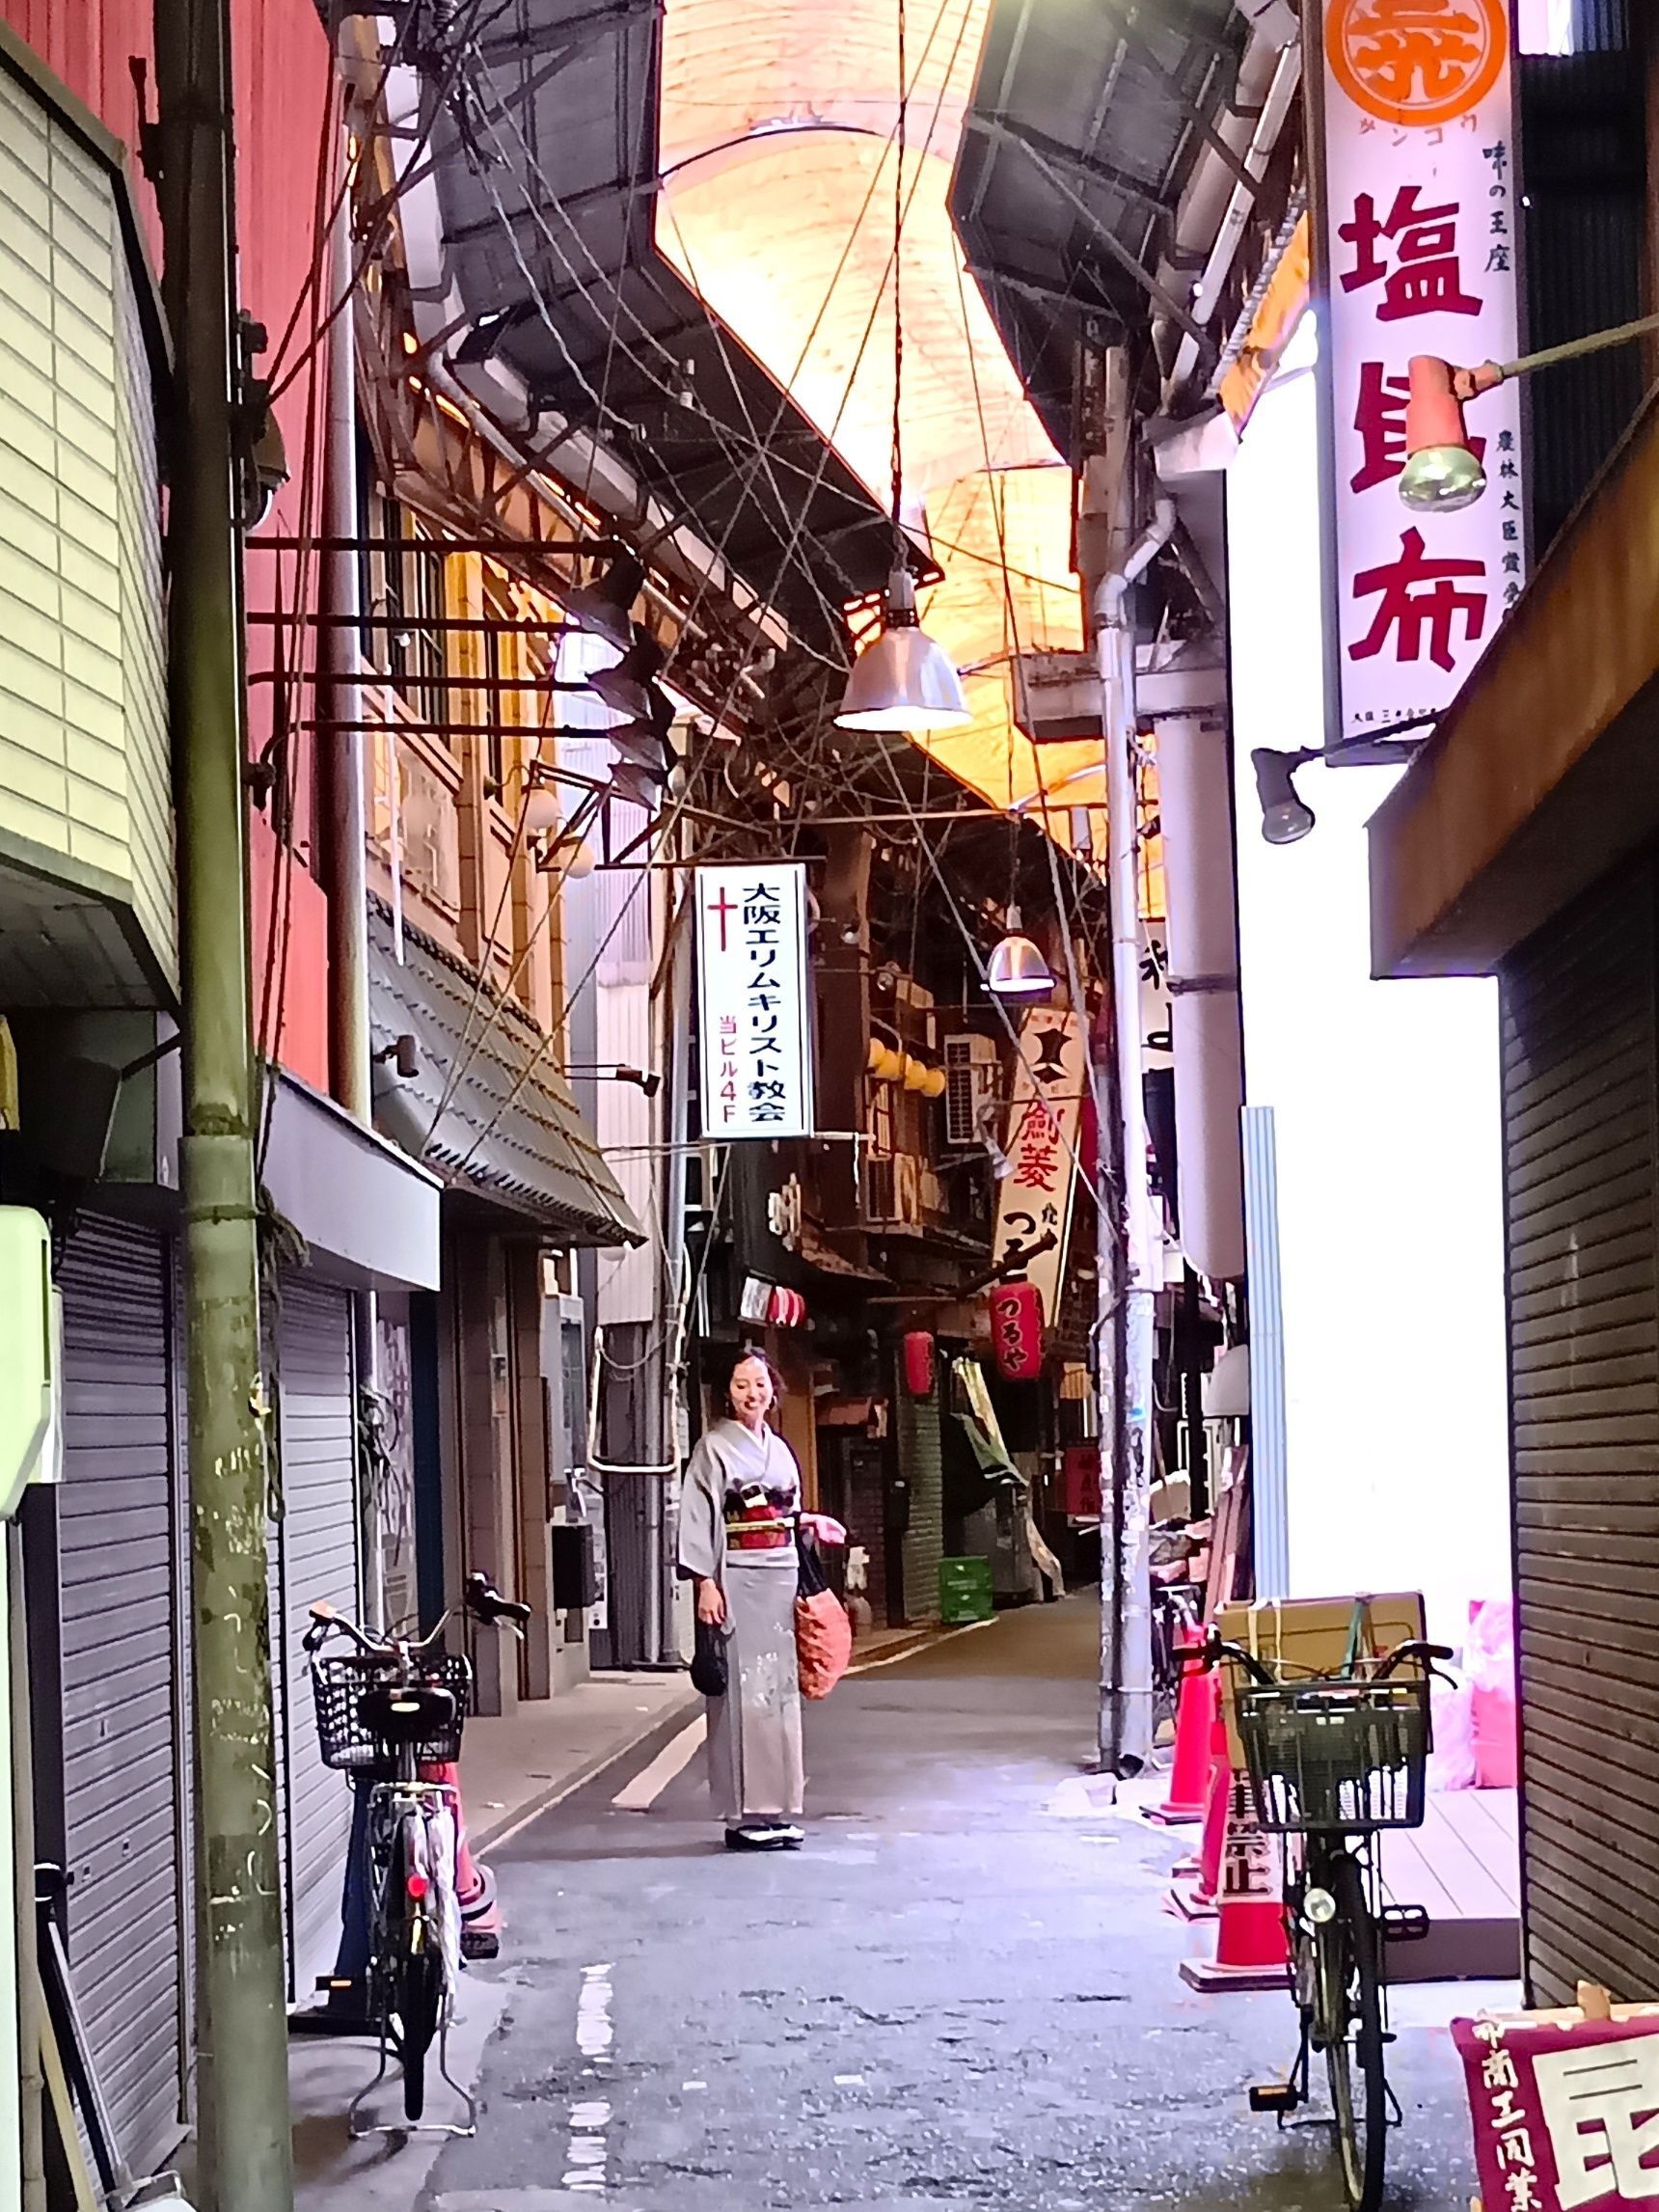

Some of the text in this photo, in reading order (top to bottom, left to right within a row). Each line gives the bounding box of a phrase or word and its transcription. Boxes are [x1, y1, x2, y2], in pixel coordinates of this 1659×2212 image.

[1482, 140, 1511, 274] 味の王座
[742, 883, 786, 1123] 大阪エリムキリスト教会
[996, 1297, 1028, 1372] つるや
[1223, 1767, 1271, 1897] 車禁止
